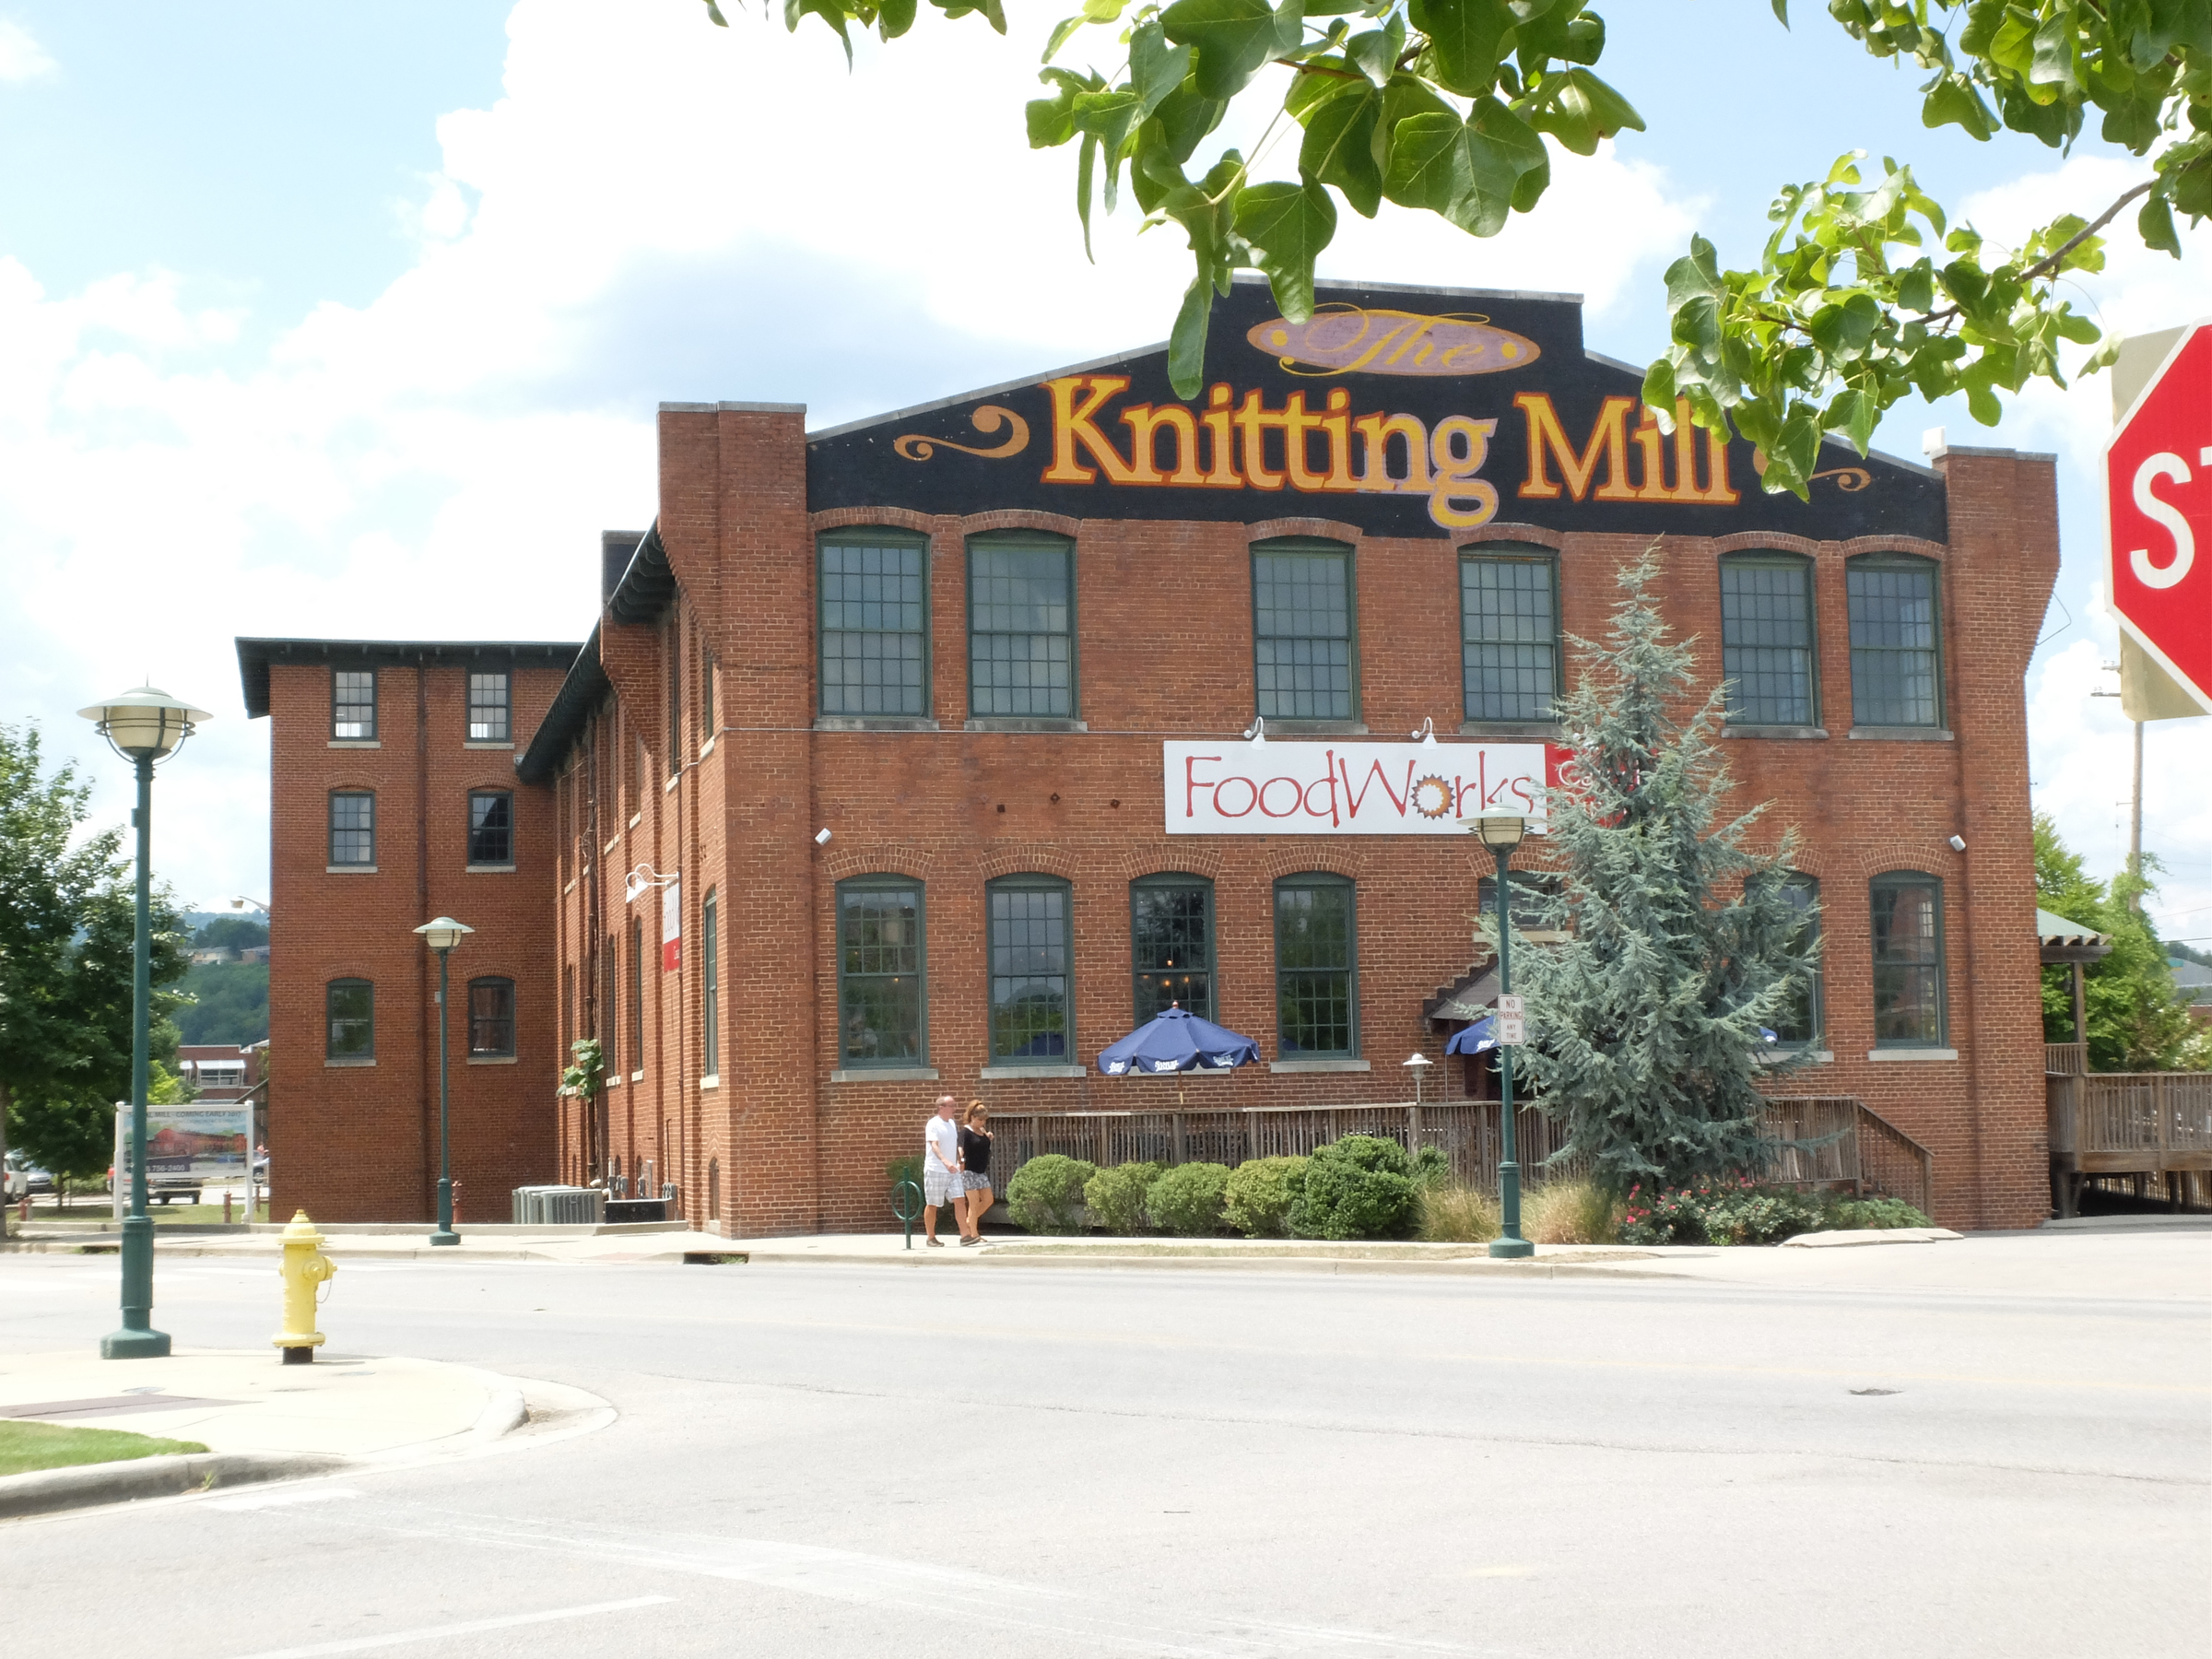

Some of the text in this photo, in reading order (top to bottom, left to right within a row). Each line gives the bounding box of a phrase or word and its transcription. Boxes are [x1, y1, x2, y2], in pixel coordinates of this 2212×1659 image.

[1279, 302, 1489, 377] The
[1038, 374, 1741, 532] Knitting Mill
[2130, 446, 2212, 589] S
[1185, 749, 1534, 828] FoodWorks
[1500, 1011, 1522, 1019] PARKING
[1505, 999, 1516, 1009] NO
